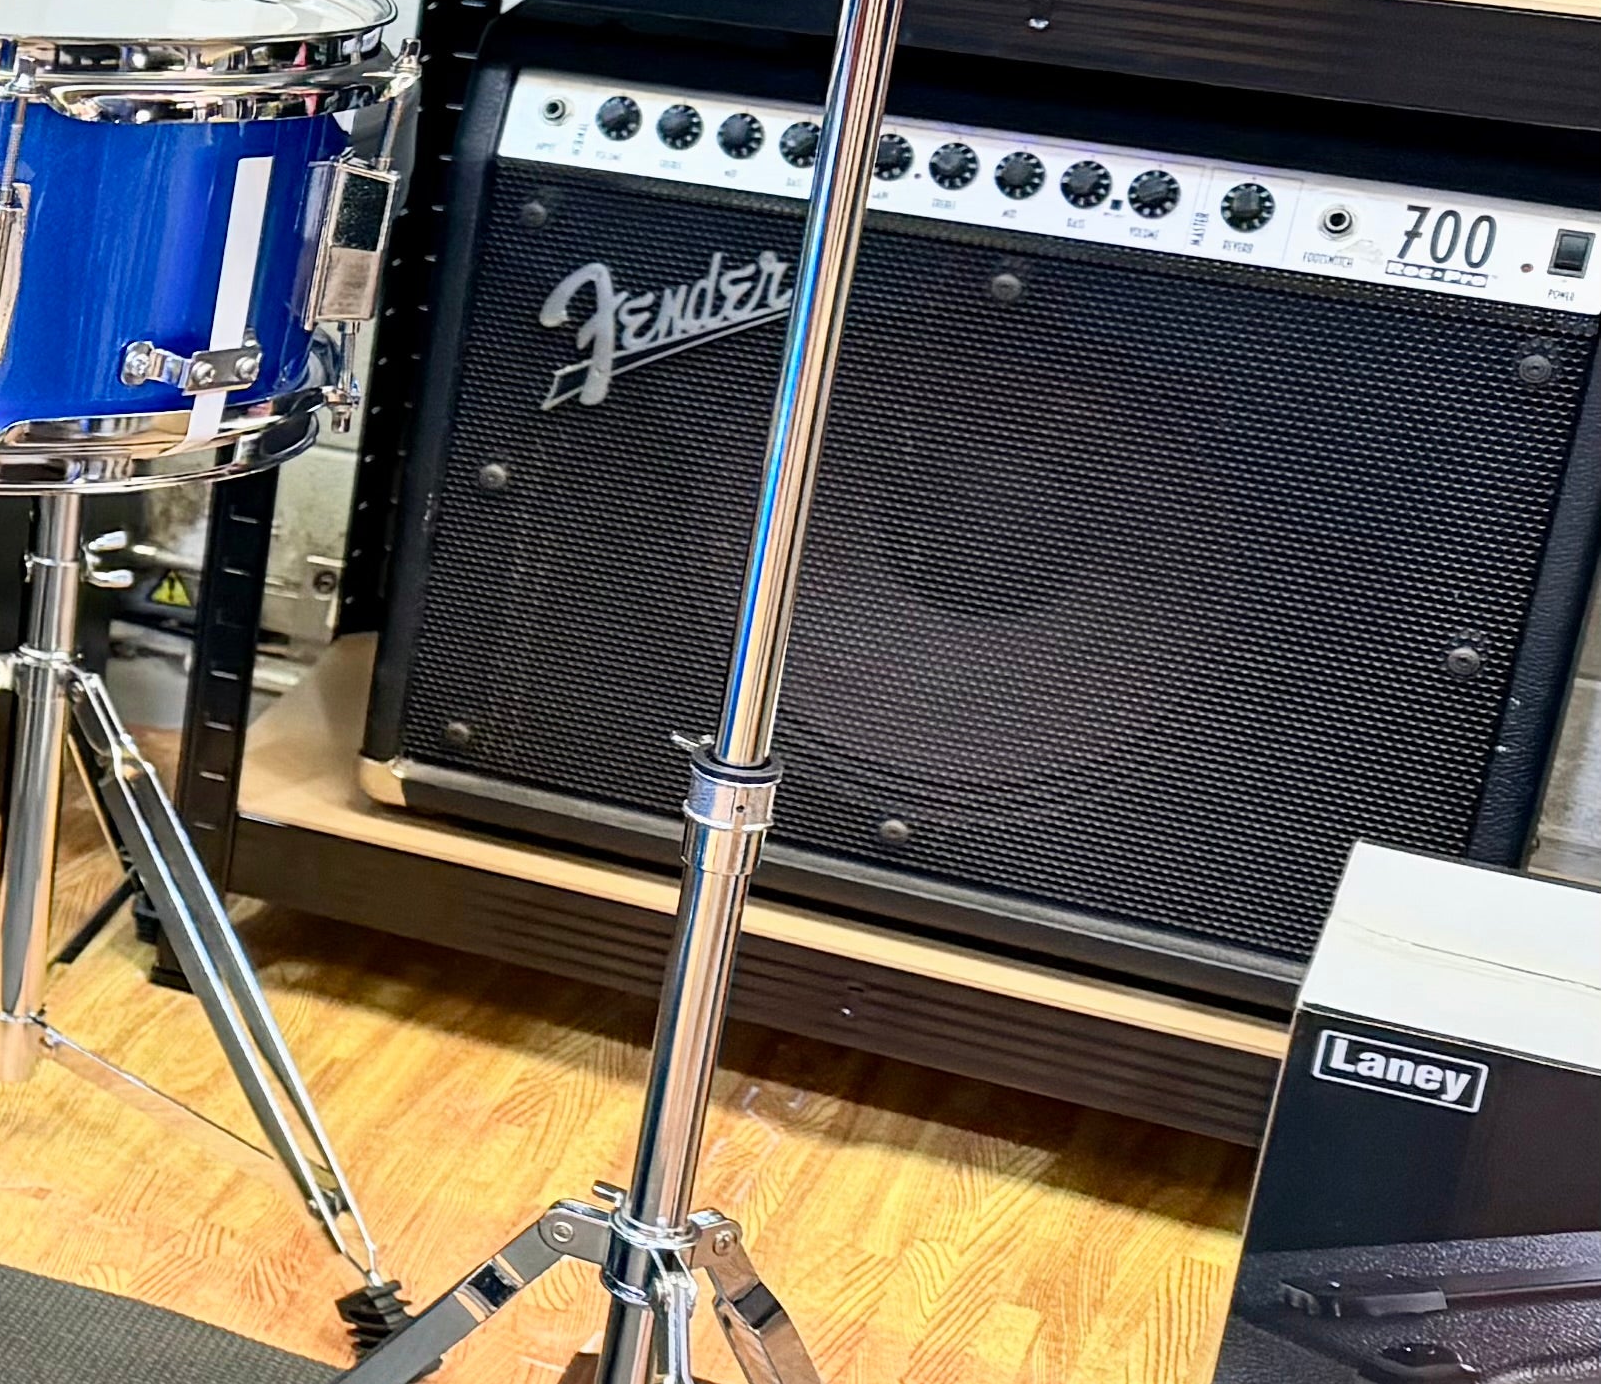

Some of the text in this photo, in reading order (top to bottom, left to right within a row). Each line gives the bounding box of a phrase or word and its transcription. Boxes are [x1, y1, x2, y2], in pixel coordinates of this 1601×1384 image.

[1397, 203, 1499, 270] 700
[539, 250, 794, 405] Fender
[1329, 1038, 1472, 1103] Laney
